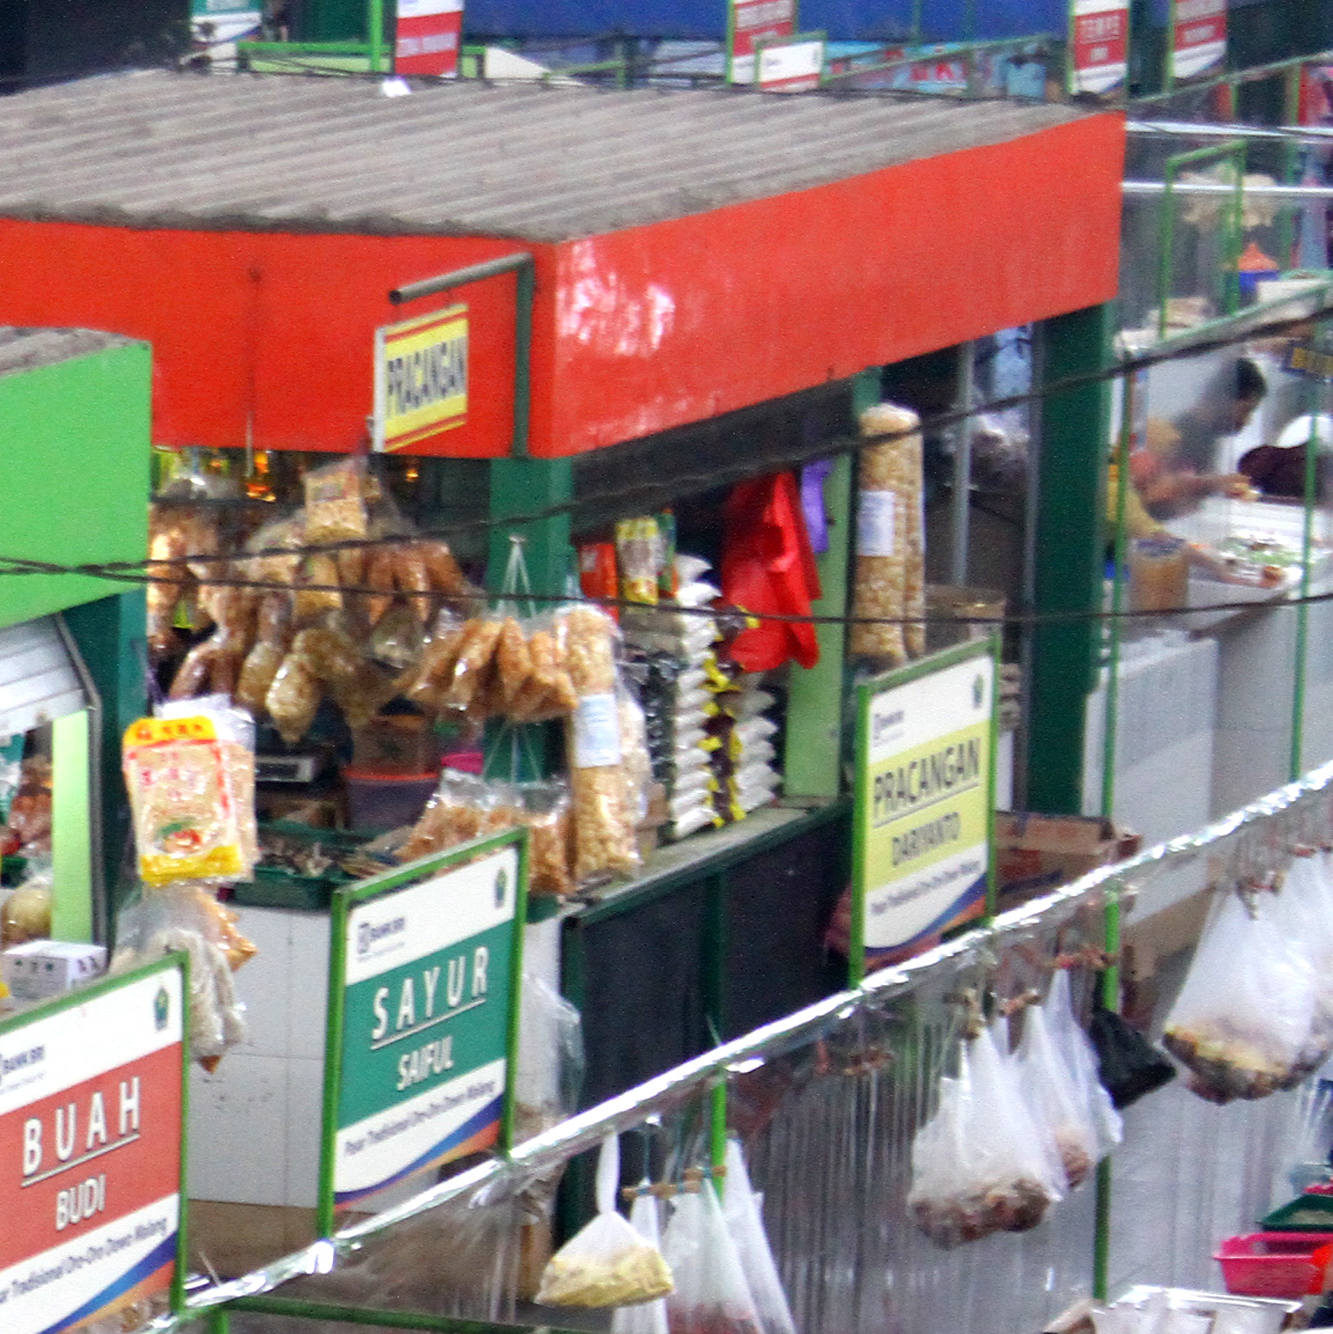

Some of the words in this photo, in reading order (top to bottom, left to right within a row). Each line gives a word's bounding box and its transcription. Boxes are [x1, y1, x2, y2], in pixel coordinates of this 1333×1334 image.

[386, 336, 466, 418] PRACANGAN
[873, 737, 980, 819] PRACANGAN
[892, 812, 960, 866] DARIYANTO
[371, 945, 489, 1041] SAYUR
[397, 1036, 454, 1092] SAIFUL
[23, 1076, 141, 1177] BUAH
[55, 1173, 107, 1232] BUDI
